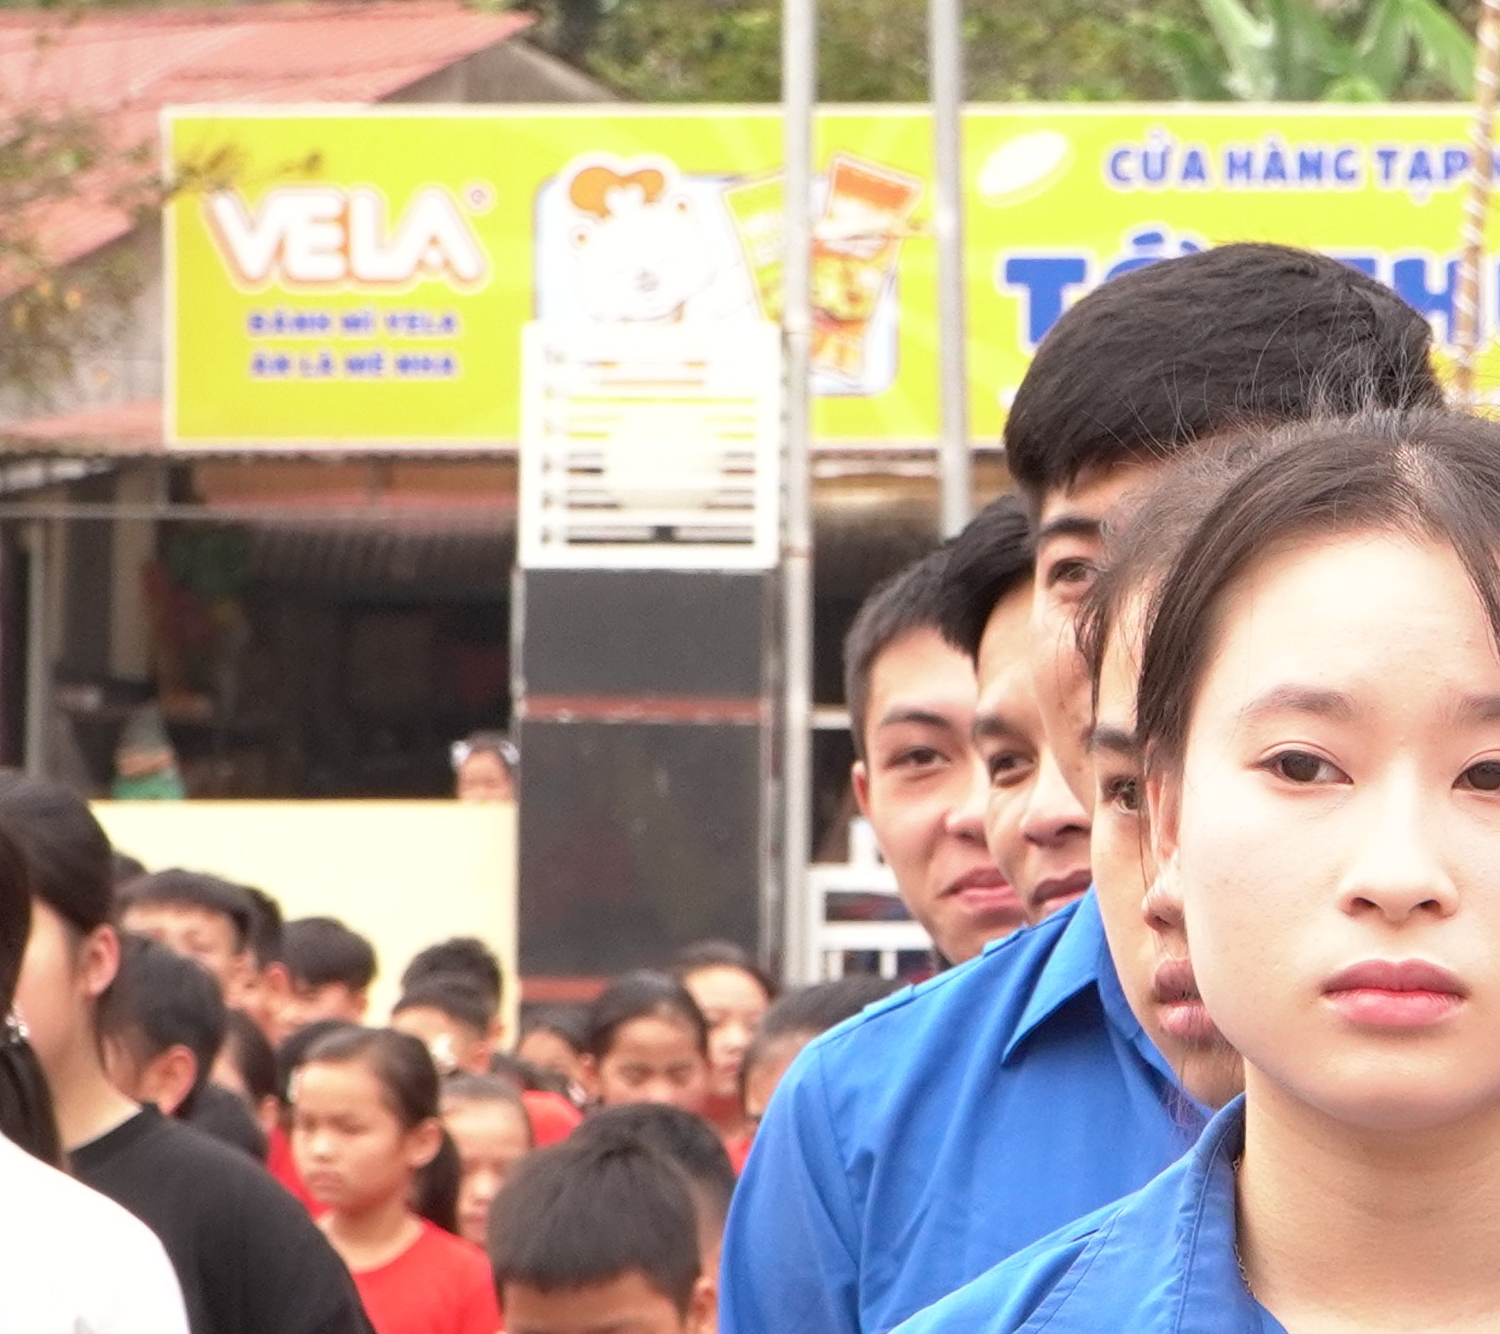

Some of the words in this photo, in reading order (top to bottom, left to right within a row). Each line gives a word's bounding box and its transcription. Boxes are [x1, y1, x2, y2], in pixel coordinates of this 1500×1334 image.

[1109, 131, 1207, 182] CỬA
[1227, 139, 1357, 183] HÀNG
[1376, 149, 1470, 199] TẠP
[211, 188, 482, 282] VELA
